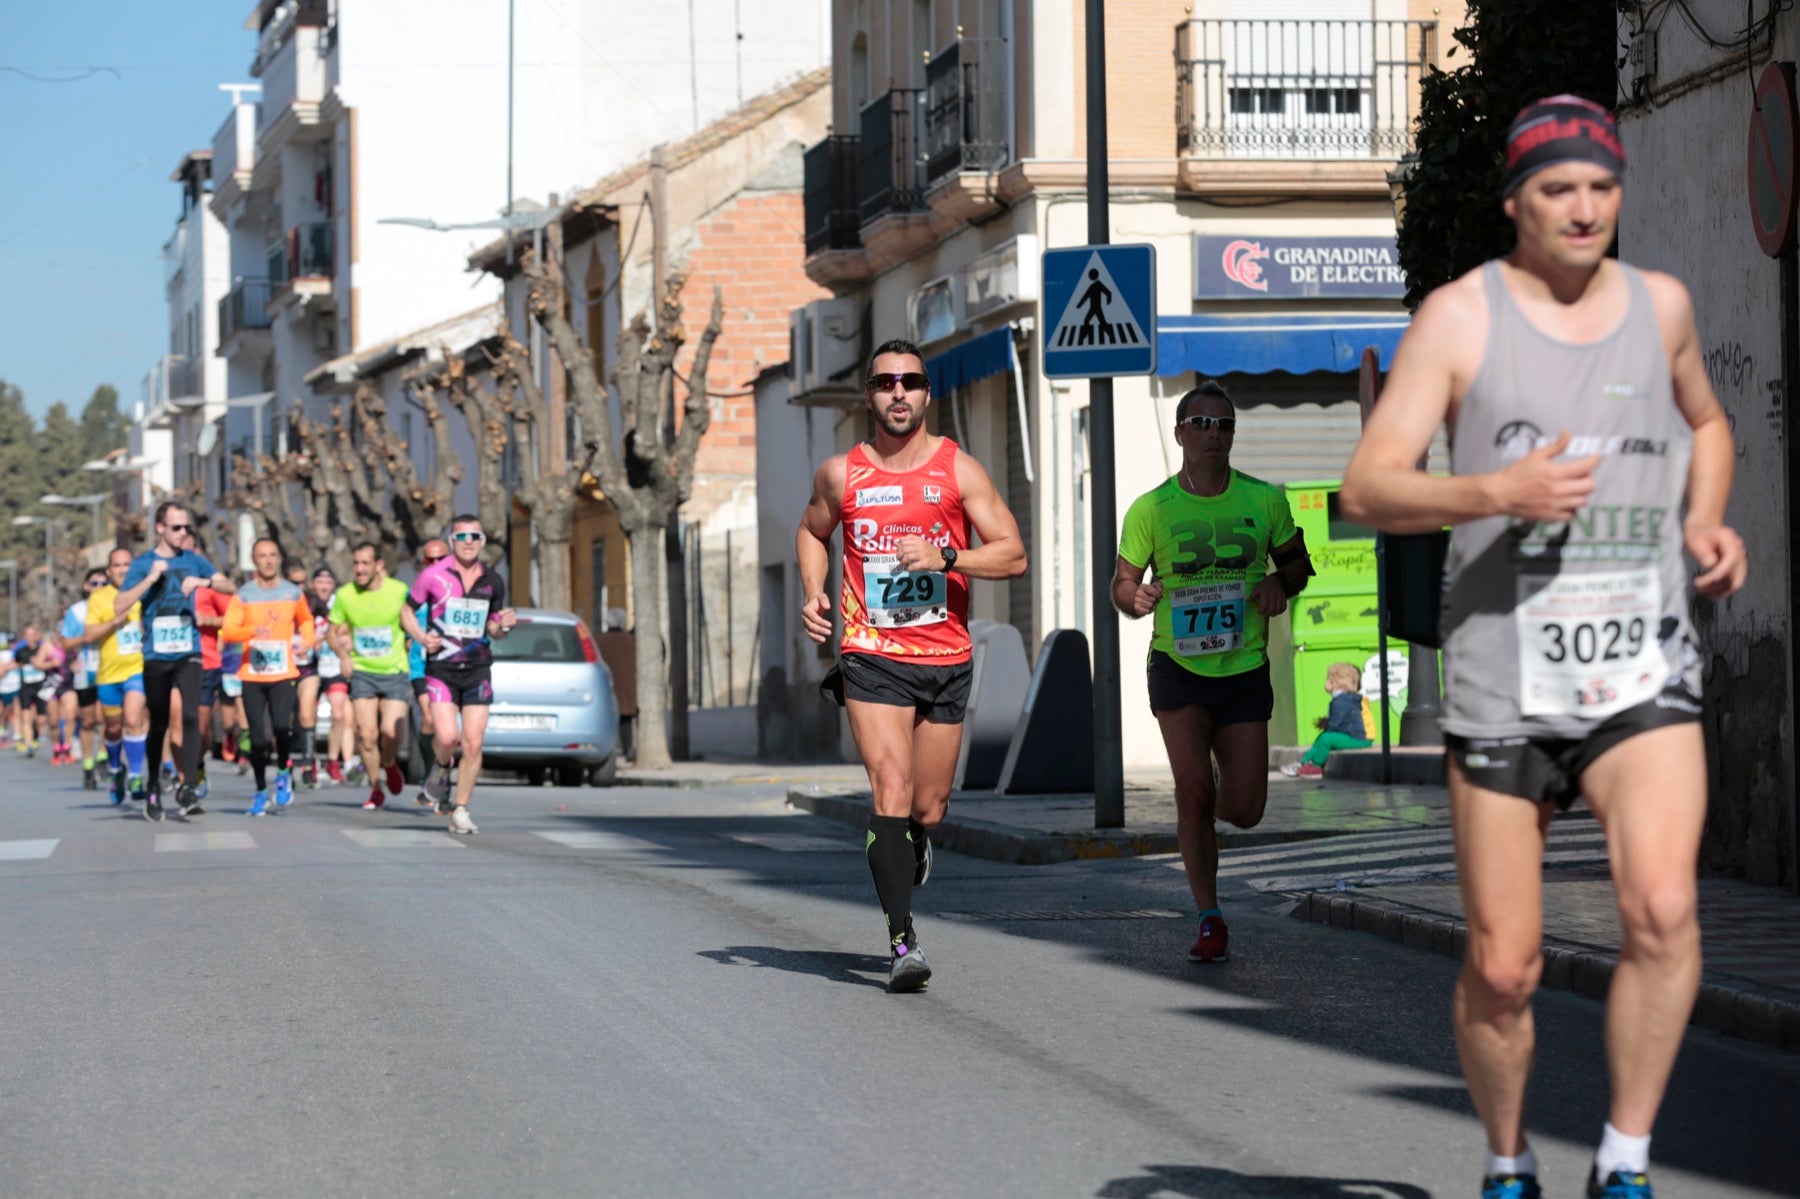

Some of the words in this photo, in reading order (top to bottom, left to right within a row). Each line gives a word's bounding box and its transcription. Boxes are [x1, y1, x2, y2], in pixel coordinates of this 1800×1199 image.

[1274, 247, 1392, 265] GRANADINA
[1290, 266, 1319, 283] DE
[925, 487, 929, 496] I
[882, 523, 923, 534] Clínicas
[1170, 516, 1258, 574] 35
[1319, 551, 1363, 570] Ropa
[877, 575, 934, 604] 729
[1187, 587, 1199, 597] GRAN
[1200, 585, 1218, 594] PREMIO
[1218, 584, 1225, 592] DE
[453, 610, 480, 626] 683
[1184, 604, 1236, 633] 775
[160, 628, 187, 640] 752
[1542, 616, 1645, 664] 3029
